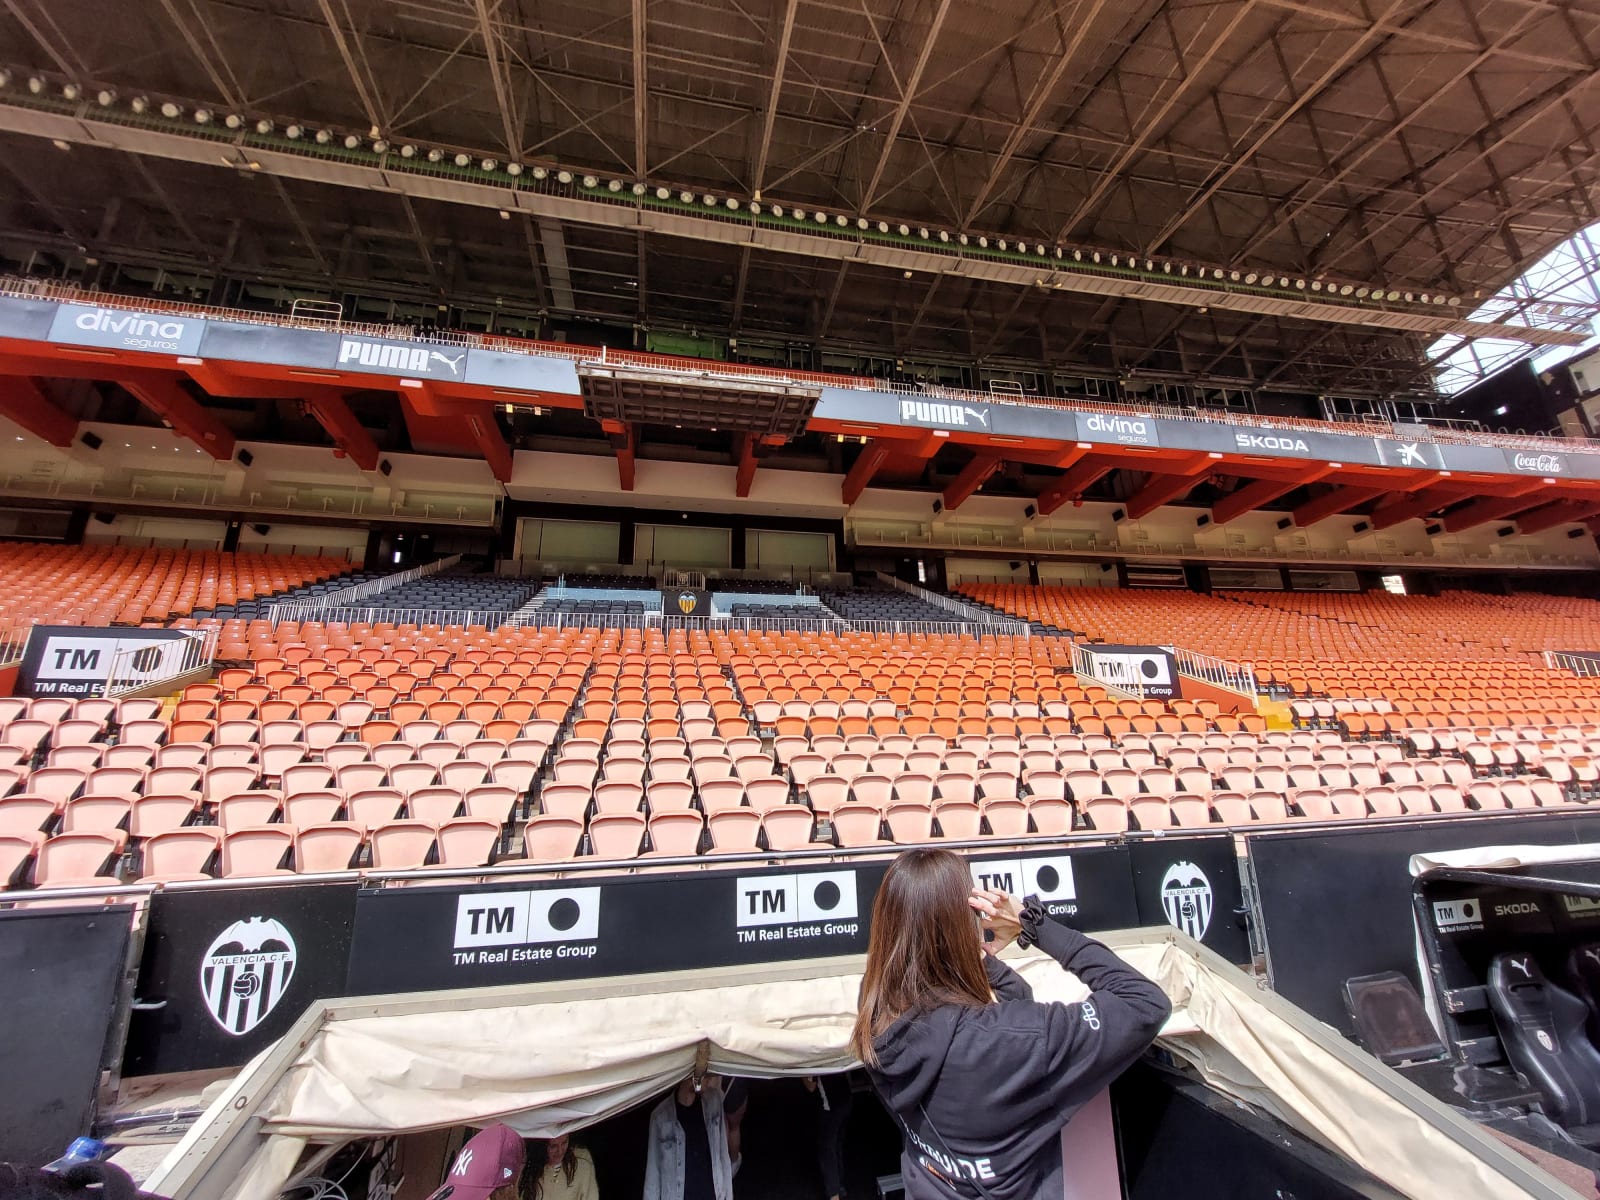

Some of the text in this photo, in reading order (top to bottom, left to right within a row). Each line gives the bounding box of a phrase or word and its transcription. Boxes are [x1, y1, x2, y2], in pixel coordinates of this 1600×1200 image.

[76, 308, 184, 339] divina
[123, 336, 178, 350] seguros
[338, 340, 430, 372] PUMA
[901, 400, 966, 425] PUMA
[1086, 414, 1147, 435] divina
[1117, 434, 1149, 443] seguros
[54, 648, 101, 670] TM
[34, 682, 57, 693] TM
[58, 682, 88, 693] Real
[1150, 686, 1173, 696] Group
[978, 872, 1014, 895] TM
[745, 888, 786, 915] TM
[1047, 903, 1078, 917] Group
[467, 906, 515, 935] TM
[1437, 907, 1455, 921] TM
[736, 922, 859, 943] TM Real Estate Group
[212, 954, 266, 965] VALENCIA
[452, 945, 597, 966] TM Real Estate Group
